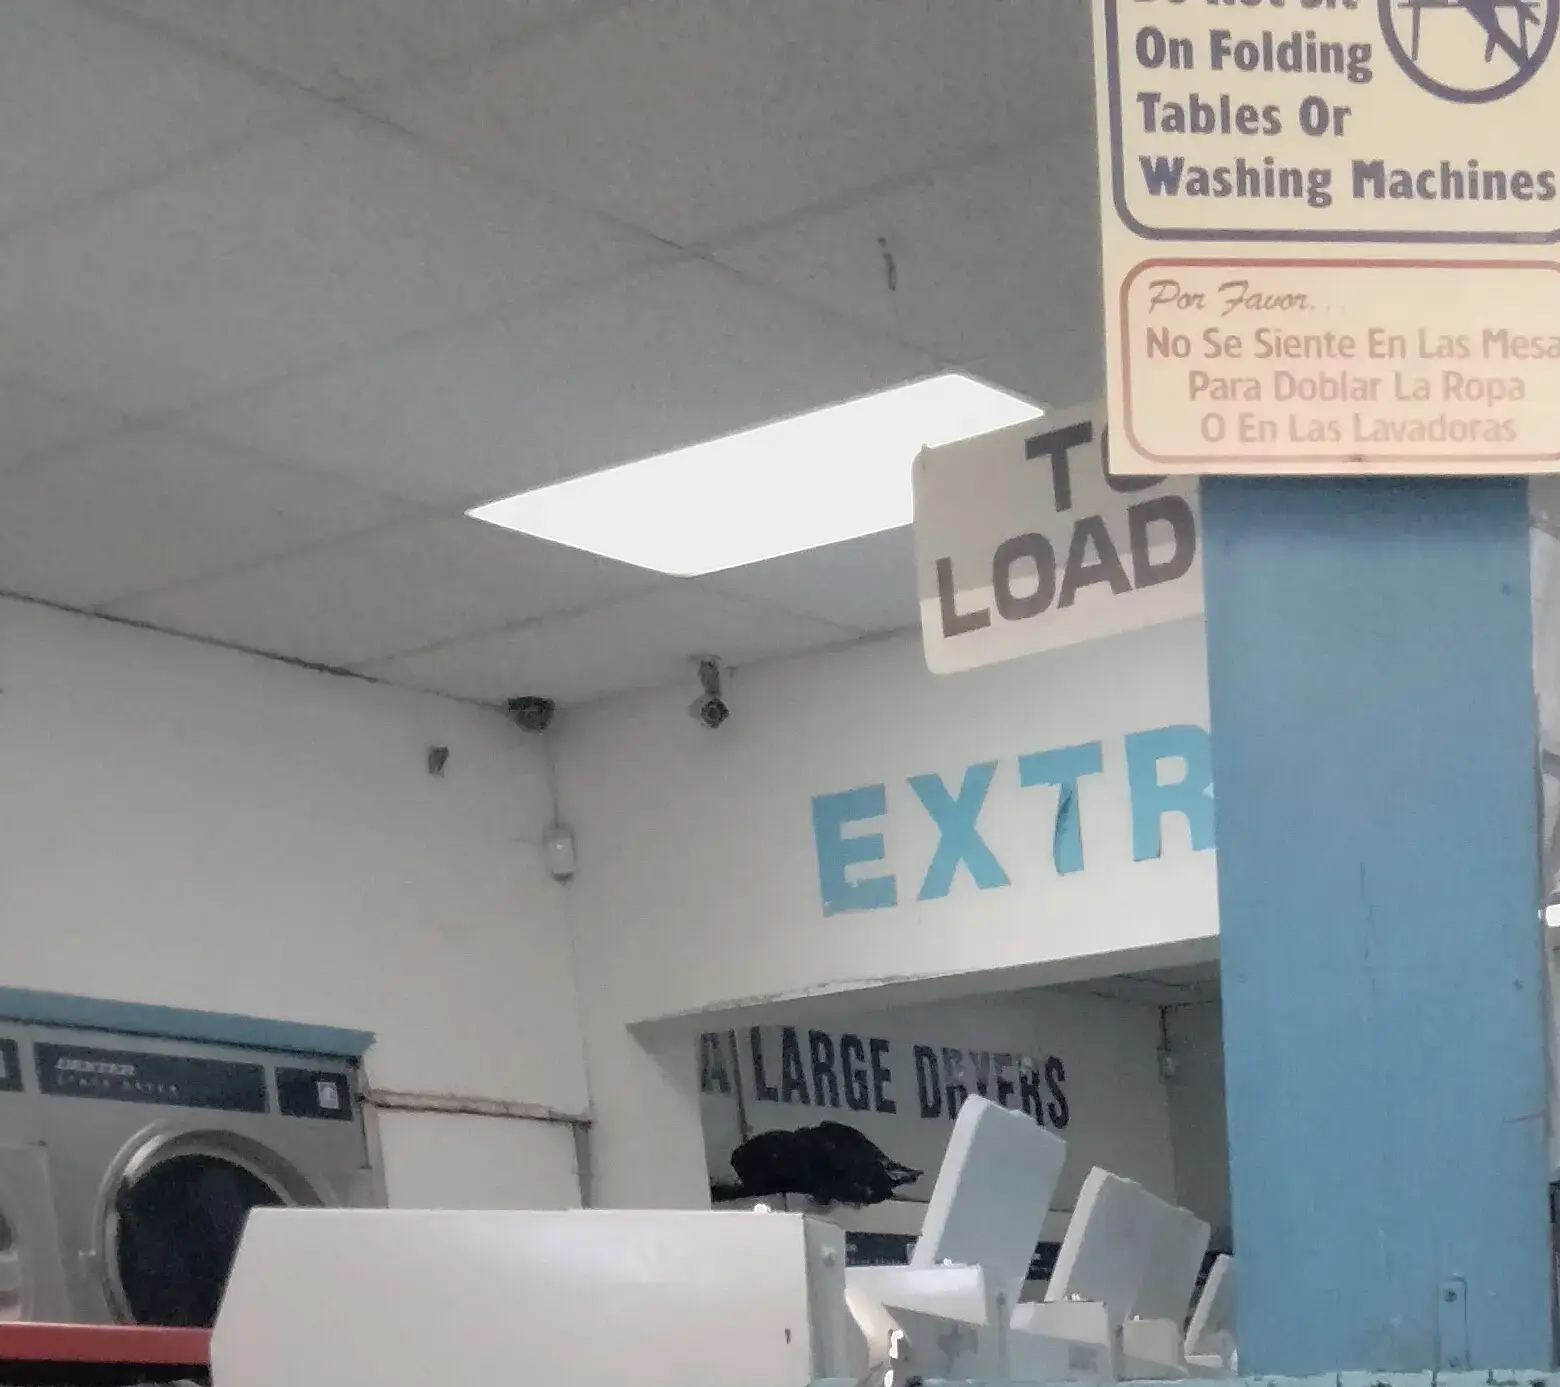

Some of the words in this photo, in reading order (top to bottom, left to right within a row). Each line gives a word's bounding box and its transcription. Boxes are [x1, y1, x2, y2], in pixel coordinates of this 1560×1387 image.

[1135, 25, 1194, 70] On
[1209, 28, 1373, 84] Folding
[1136, 91, 1282, 136] Tables
[1300, 95, 1352, 136] Or
[1138, 155, 1332, 208] Washing
[1351, 158, 1556, 201] Machines
[1148, 278, 1206, 315] Por
[1146, 326, 1191, 359] No
[1202, 327, 1242, 359] Se
[1254, 327, 1356, 359] Siente
[1368, 327, 1406, 359] En
[1417, 327, 1471, 359] Las
[1189, 370, 1262, 401] Para
[1274, 370, 1382, 401] Doblar
[1394, 370, 1431, 401] La
[1442, 370, 1526, 407] Ropa
[1201, 412, 1226, 443] O
[1238, 411, 1277, 443] En
[1289, 413, 1342, 443] Las
[1352, 411, 1517, 443] Lavadoras
[1025, 420, 1168, 512] T
[935, 494, 1197, 638] LOAD
[750, 1026, 897, 1115] LARGE
[913, 1043, 1070, 1129] DRYERS
